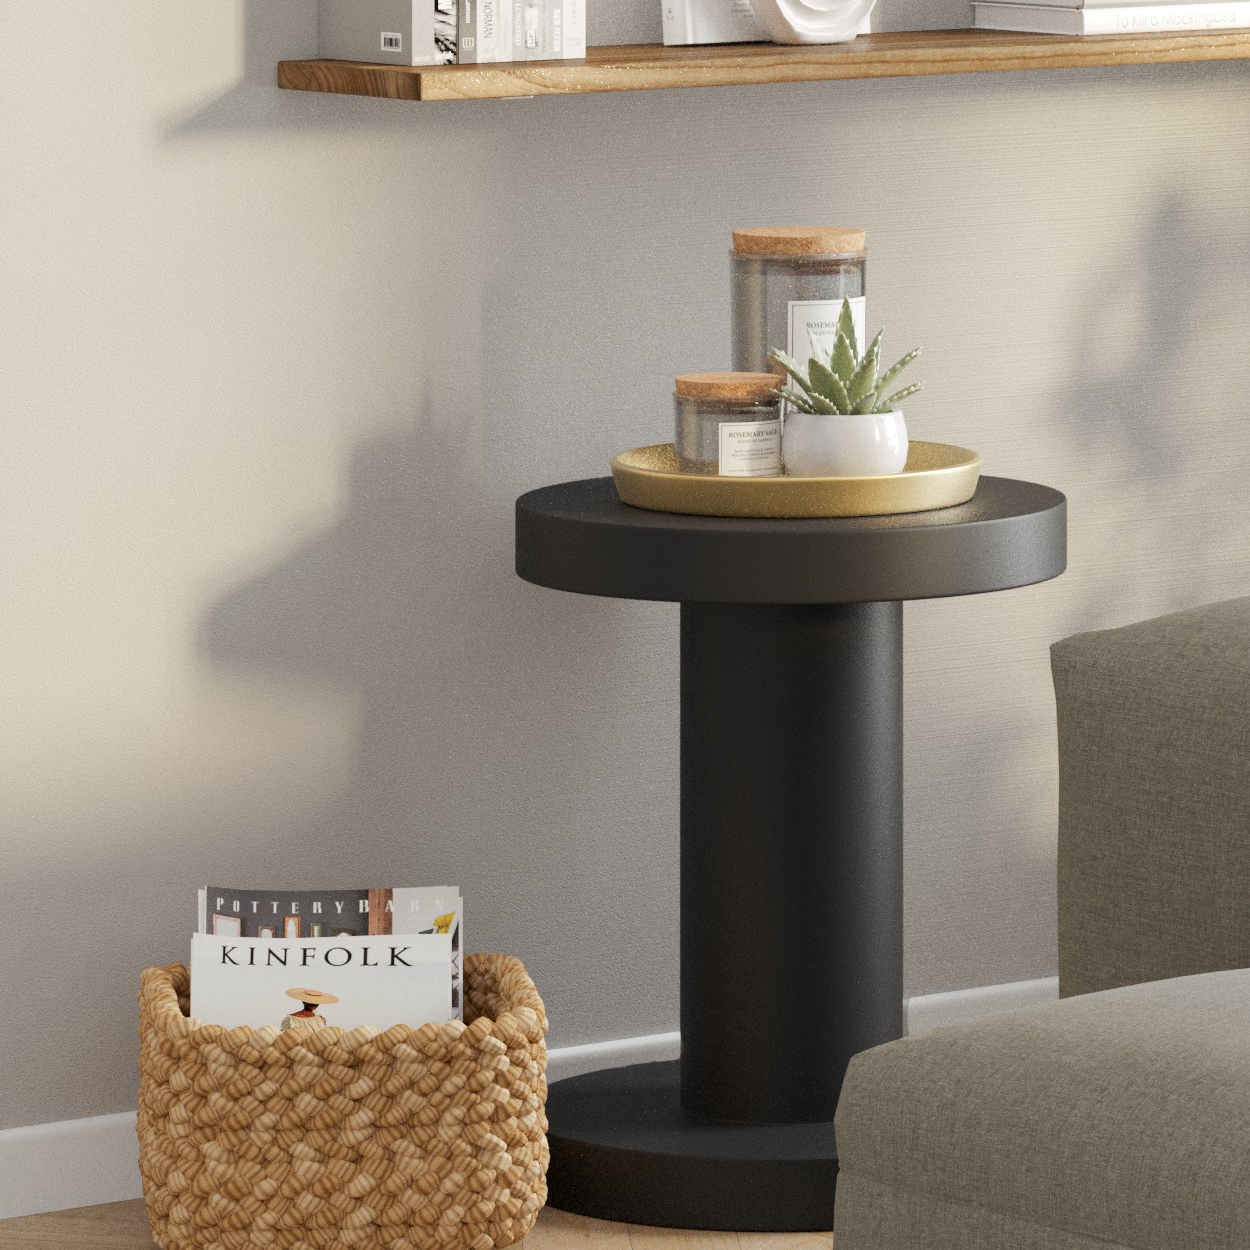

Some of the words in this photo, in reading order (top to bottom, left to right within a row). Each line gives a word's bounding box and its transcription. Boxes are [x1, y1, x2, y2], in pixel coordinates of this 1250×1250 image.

[483, 1, 493, 39] NORMAN
[1115, 14, 1129, 28] To
[1132, 14, 1147, 27] Kill
[1150, 16, 1159, 26] a
[1162, 11, 1237, 28] Mockingbird
[728, 429, 766, 438] ROSEMARY
[220, 945, 414, 967] KINFOLK
